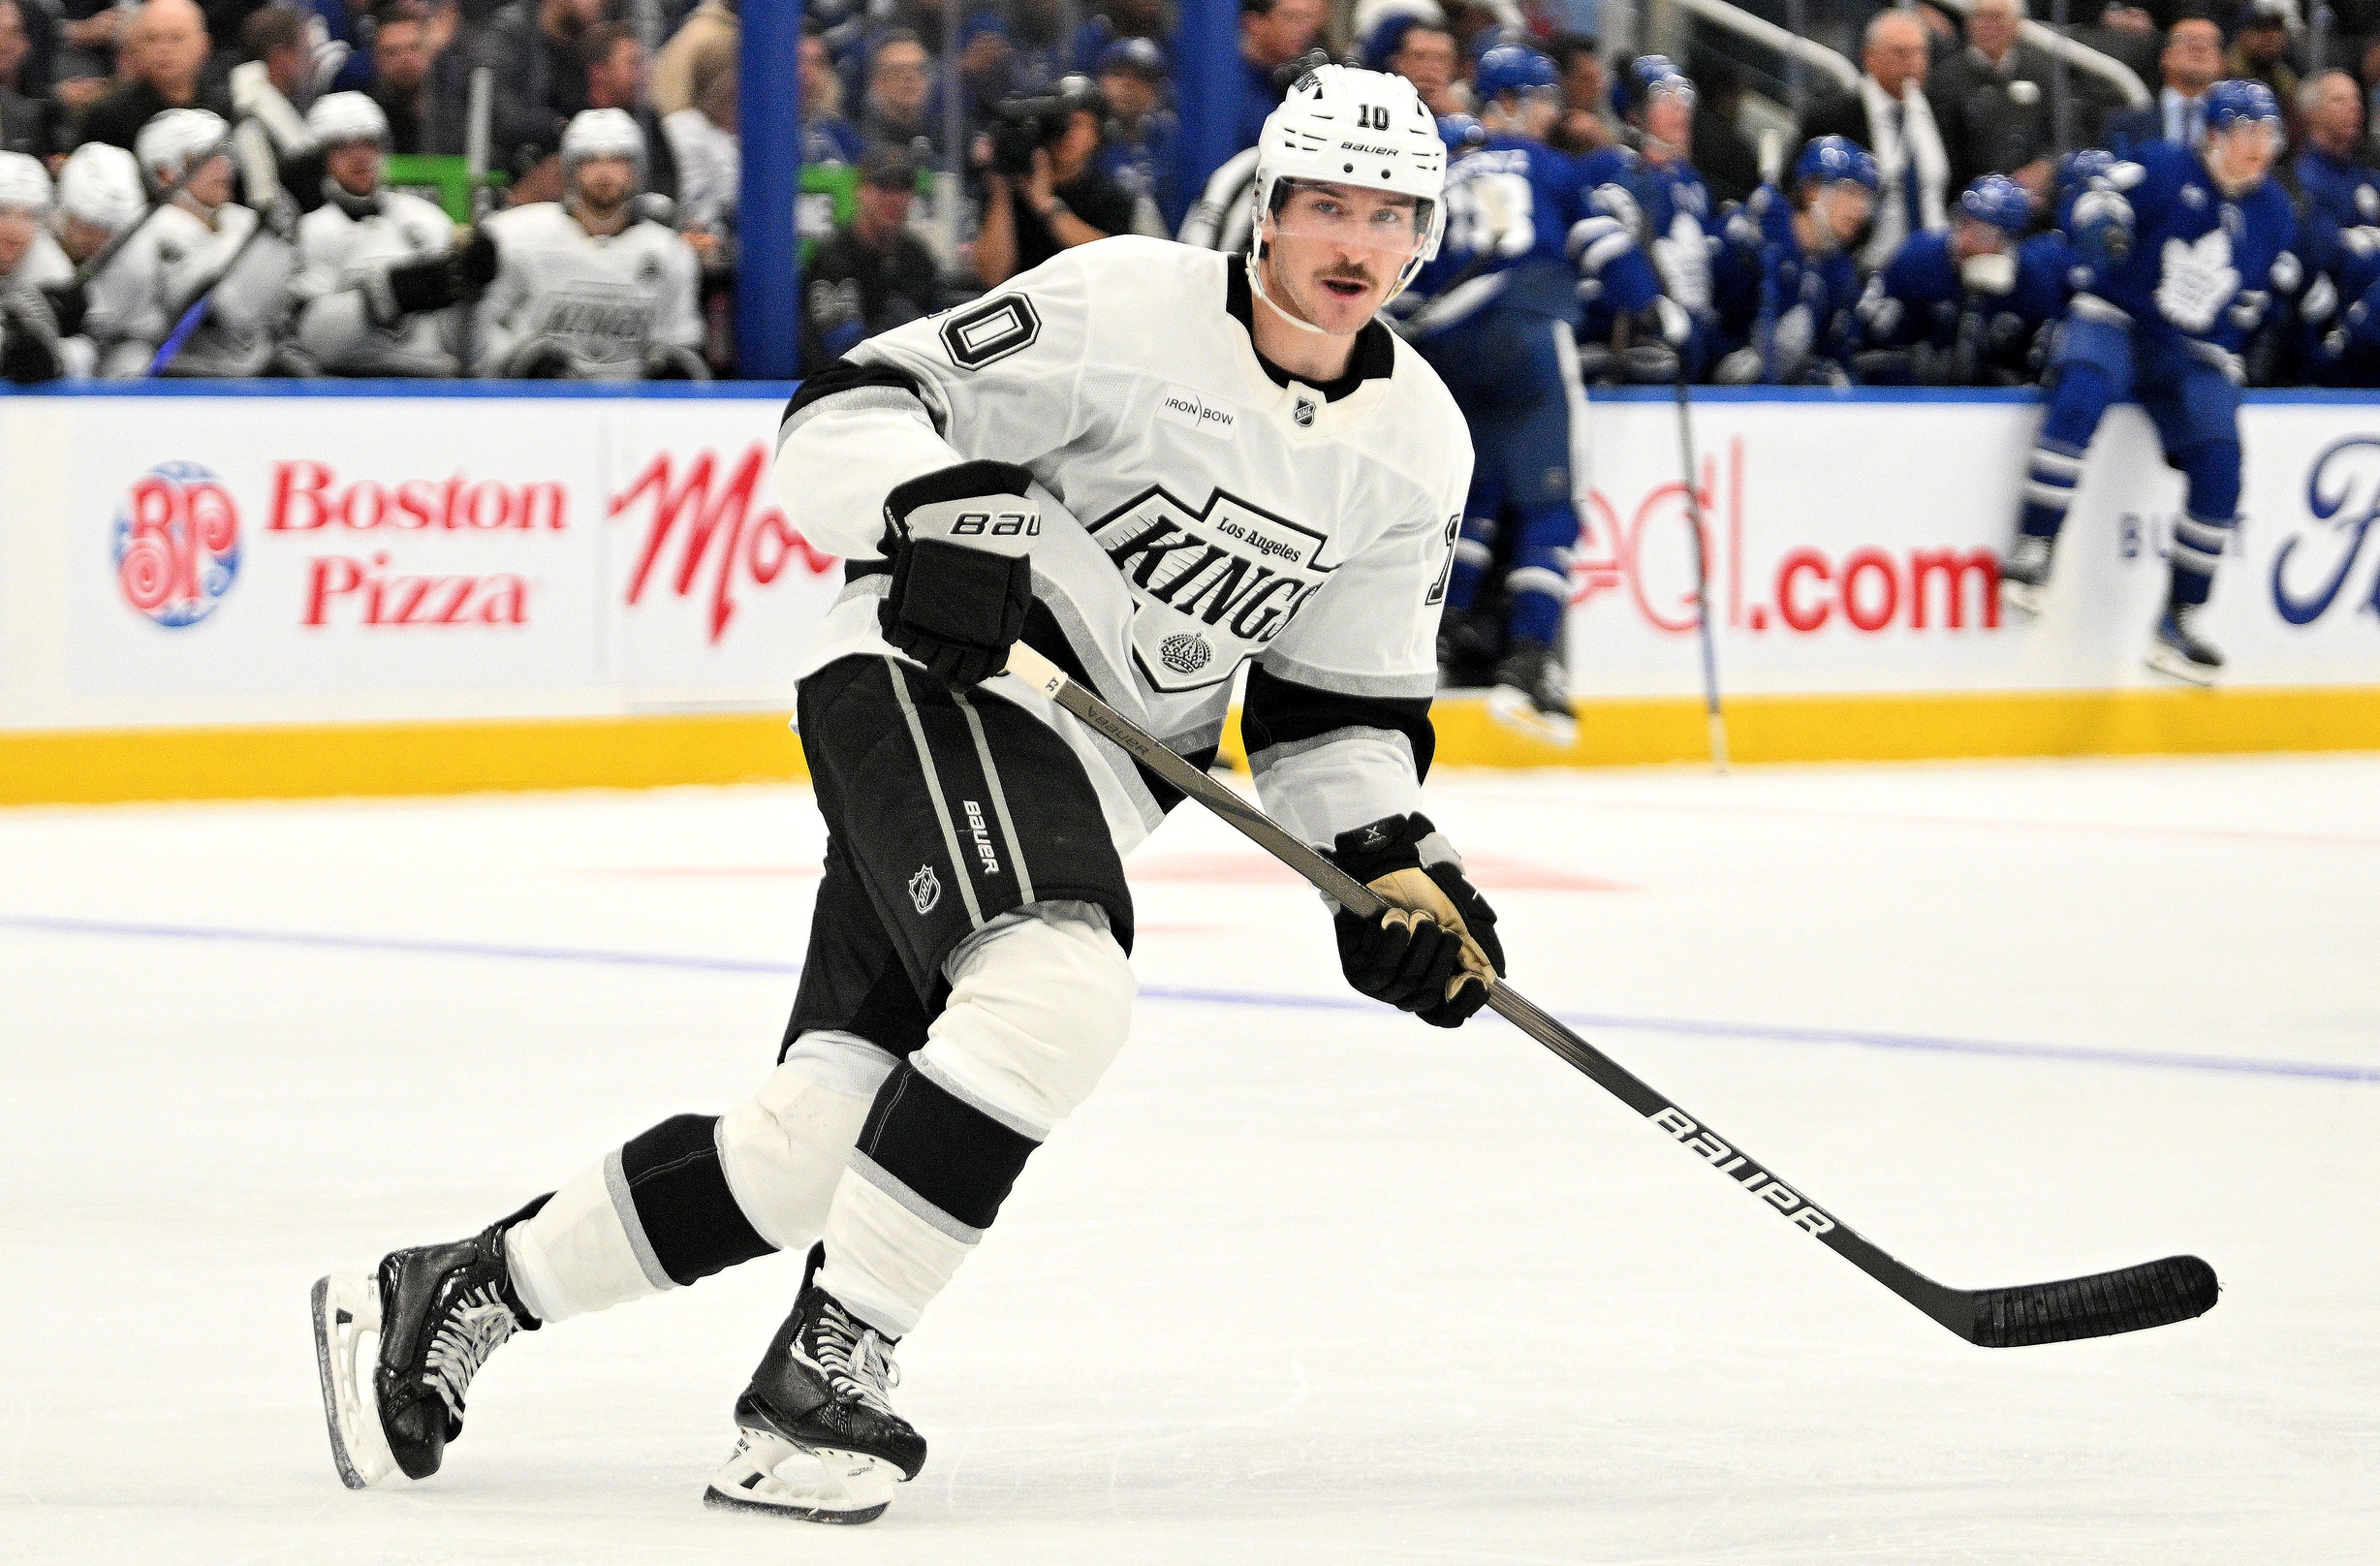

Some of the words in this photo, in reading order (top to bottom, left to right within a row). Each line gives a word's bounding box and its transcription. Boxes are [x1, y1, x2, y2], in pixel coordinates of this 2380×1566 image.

[1357, 103, 1391, 132] 10
[927, 291, 1043, 372] 0
[1164, 396, 1199, 415] IRON
[1202, 407, 1235, 425] BOW
[261, 458, 571, 532] Boston
[2269, 432, 2380, 626] F
[606, 441, 840, 647] Mo
[1216, 516, 1246, 539] Los
[1245, 529, 1302, 563] Angeles
[298, 548, 529, 627] Pizza
